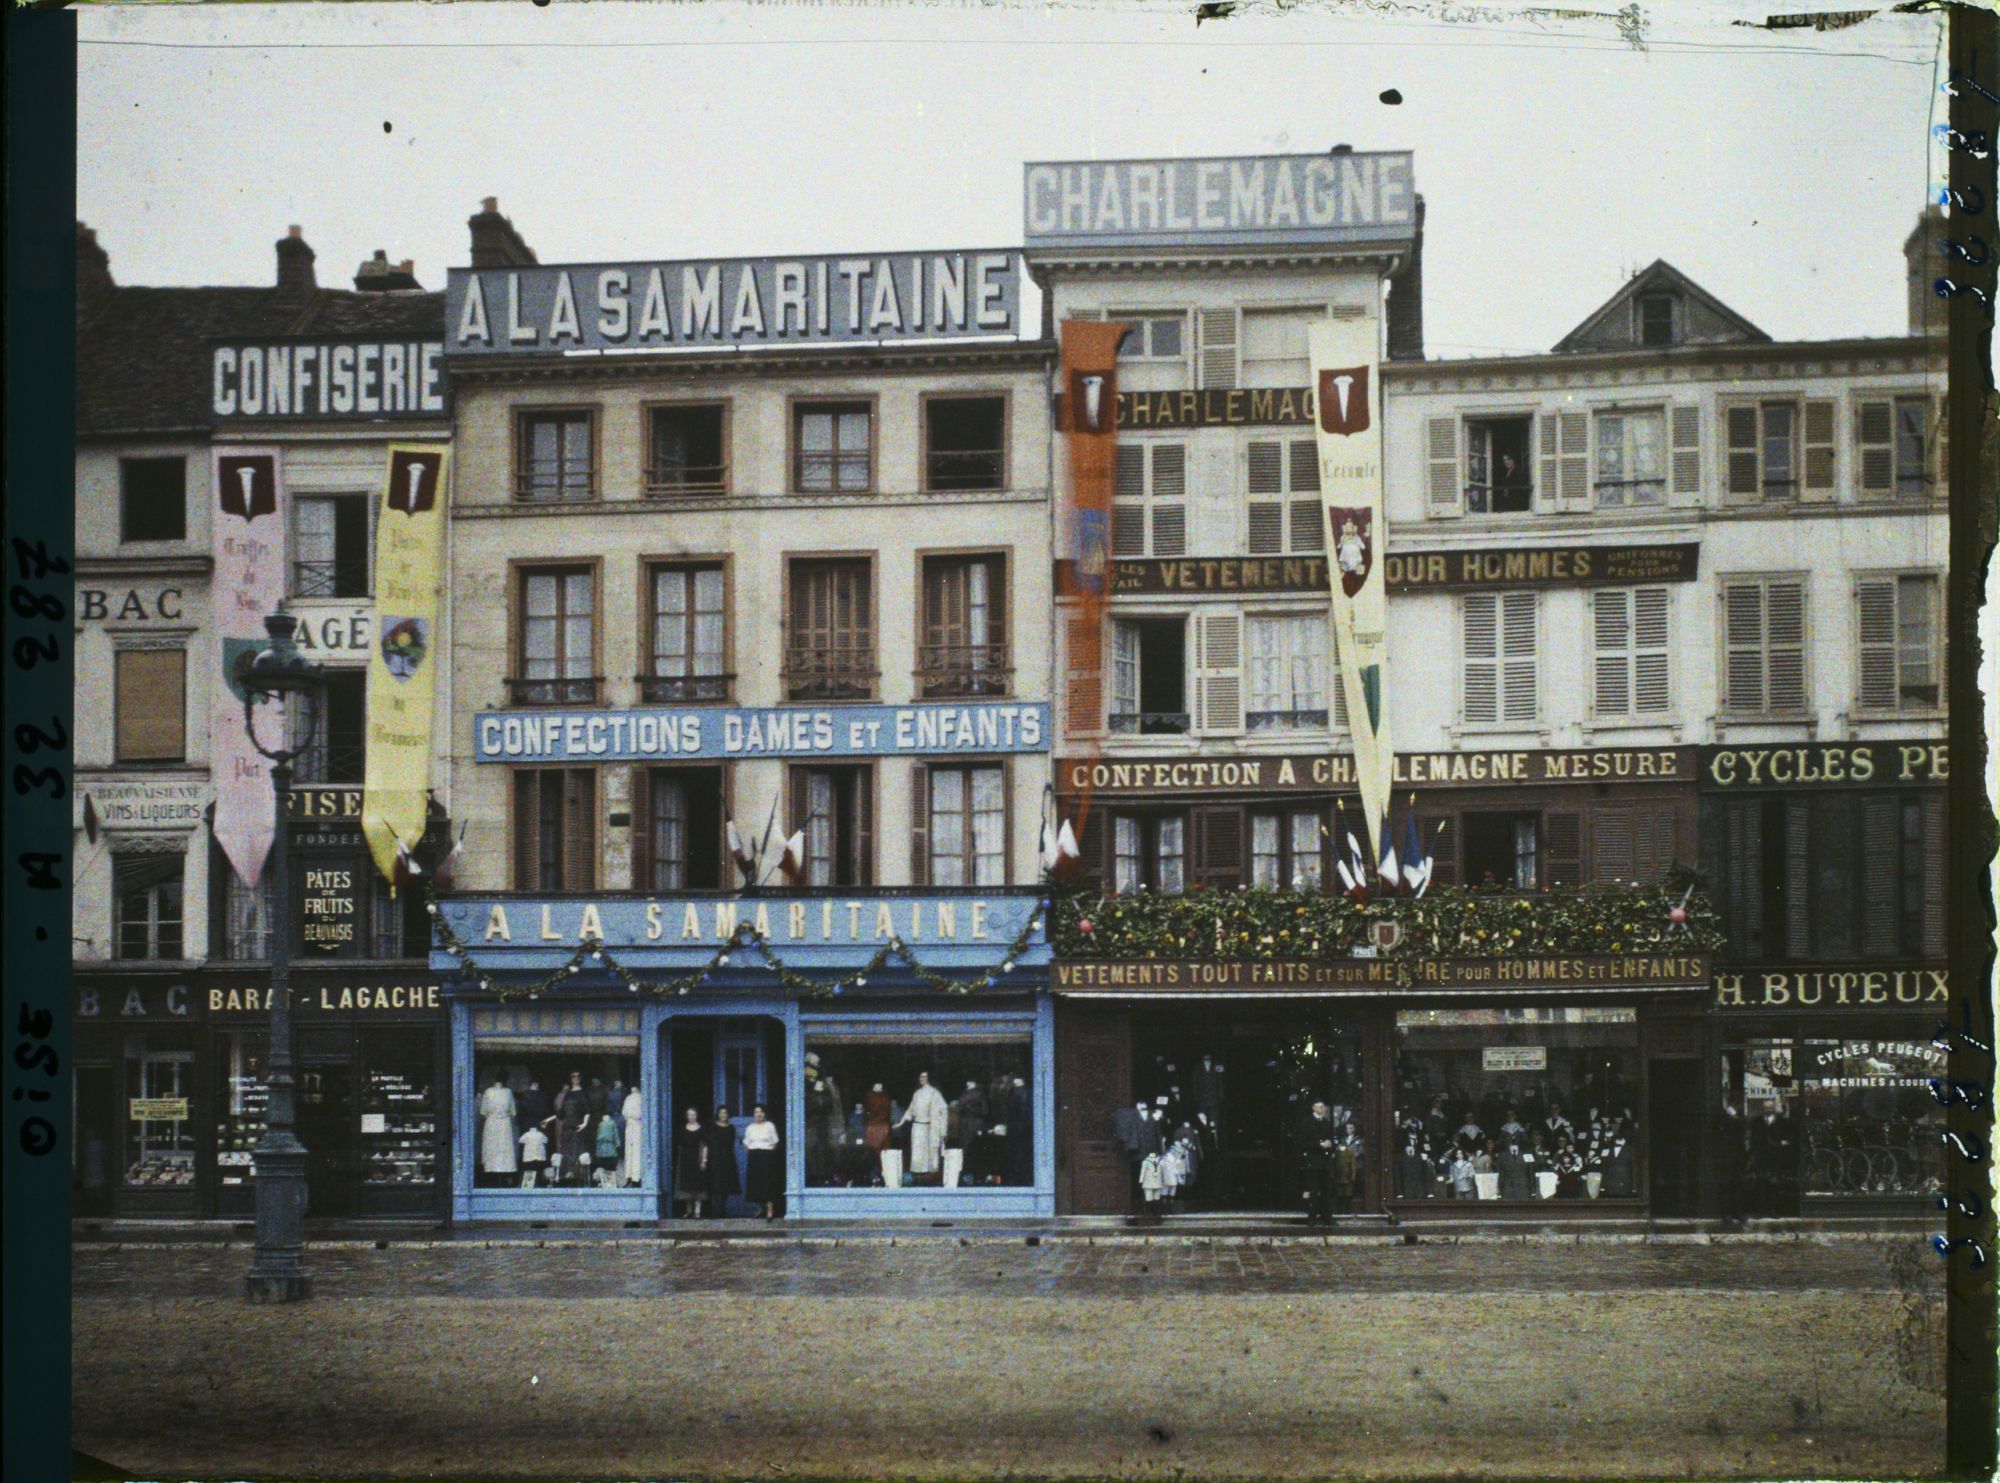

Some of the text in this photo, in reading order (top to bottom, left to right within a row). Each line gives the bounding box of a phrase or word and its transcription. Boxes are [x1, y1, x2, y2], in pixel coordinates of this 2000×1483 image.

[1027, 155, 1410, 232] CHARLEMAGNE
[457, 254, 1009, 344] A LA SAMARITAINE
[213, 342, 443, 416] CONFISERIE
[1385, 555, 1447, 583] OUR
[1462, 550, 1592, 582] HOMMES
[80, 588, 183, 621] BAC
[295, 609, 370, 650] AGÉ
[481, 705, 1044, 757] CONFECTIONS DAMES ET ENFANTS
[1071, 762, 1261, 789] CONFECTION
[1278, 758, 1296, 784] A
[1544, 752, 1677, 779] MESURE
[1709, 747, 1874, 784] CYCLES
[103, 804, 132, 820] VINS
[140, 804, 201, 822] LIQUEURS
[306, 868, 352, 889] PÂTES
[304, 898, 354, 914] FRUITS
[484, 899, 989, 941] A LA SAMARITAINE
[304, 923, 353, 941] BEAUVAISIS
[1057, 963, 1180, 985] VETEMENTS
[1188, 962, 1243, 984] TOUT
[1251, 962, 1309, 984] FAITS
[1315, 968, 1333, 982] ET
[1337, 968, 1364, 982] SUR
[1456, 966, 1492, 981] POUR
[1497, 958, 1585, 981] HOMMES
[1588, 965, 1605, 979] ET
[1609, 957, 1702, 979] ENFANTS
[320, 985, 441, 1011] LAGACHE
[1816, 1042, 1942, 1066] CYCLES PEUGEOT
[1821, 1077, 1886, 1088] MACHINES
